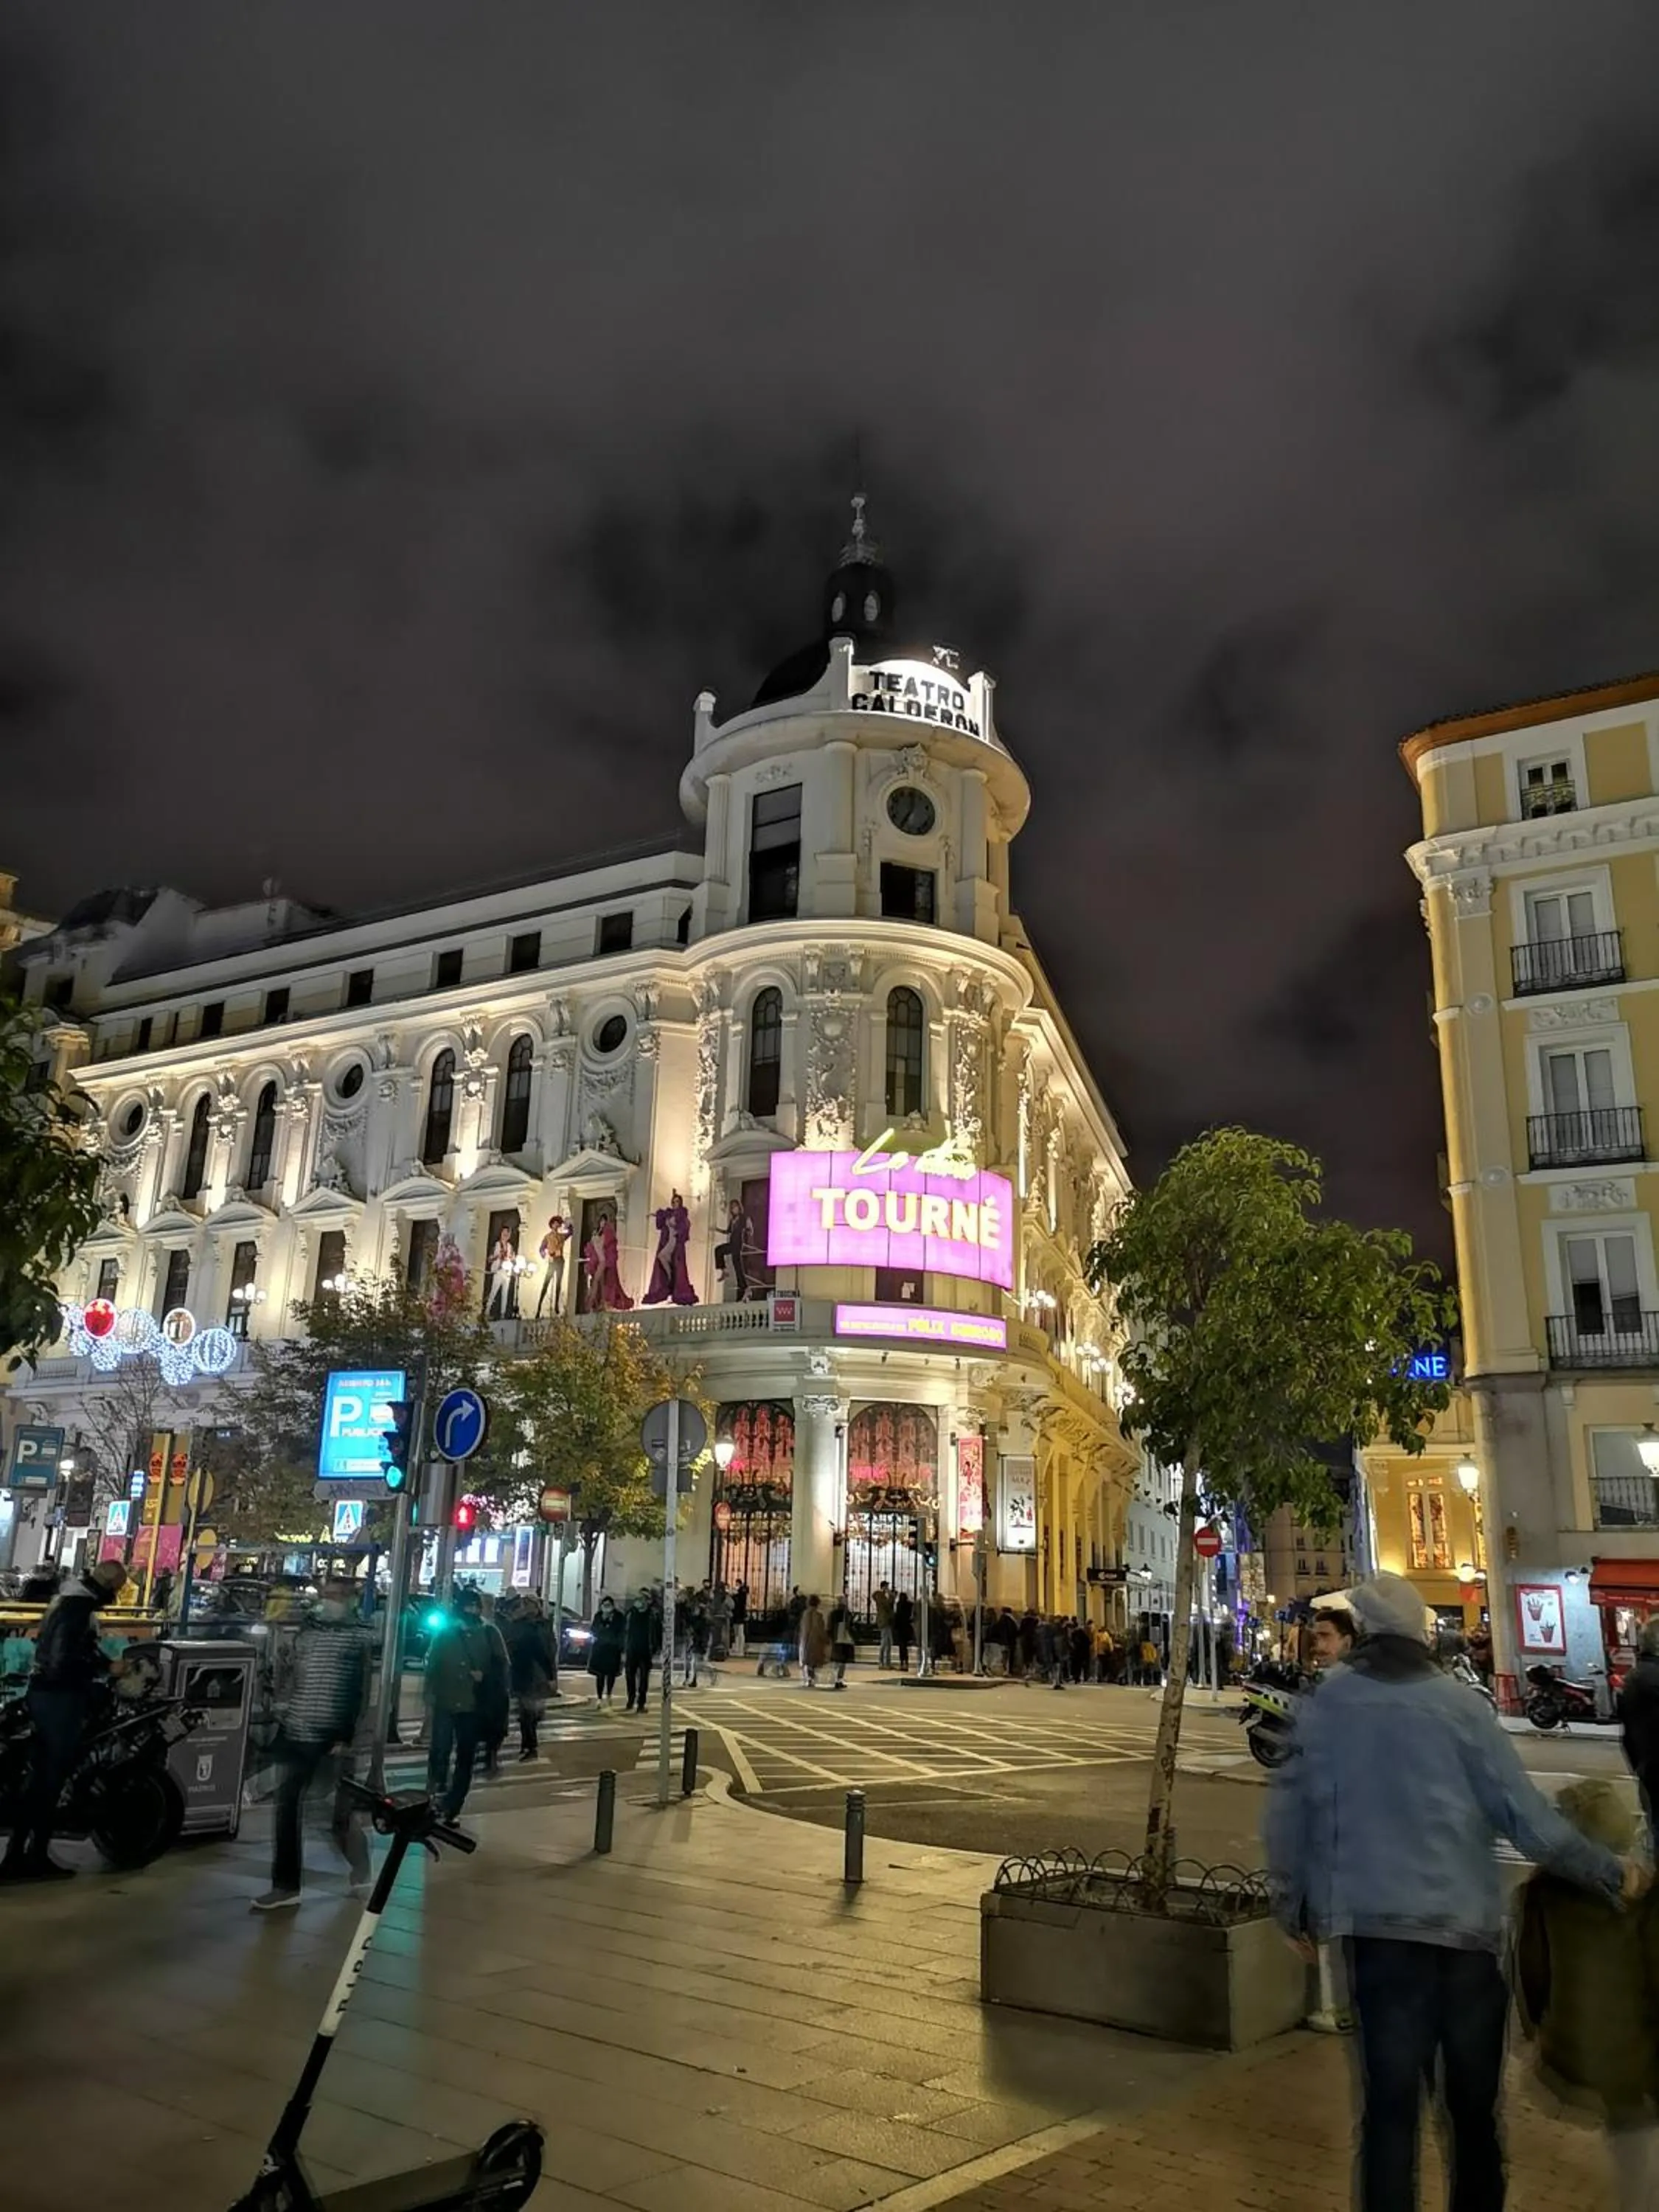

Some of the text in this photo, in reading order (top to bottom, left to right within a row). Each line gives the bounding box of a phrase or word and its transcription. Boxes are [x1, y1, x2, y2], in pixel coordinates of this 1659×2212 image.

[869, 670, 964, 711] TEATRO
[811, 1187, 1001, 1250] TOURNÉ
[330, 1395, 363, 1438] P
[17, 1439, 38, 1464] P
